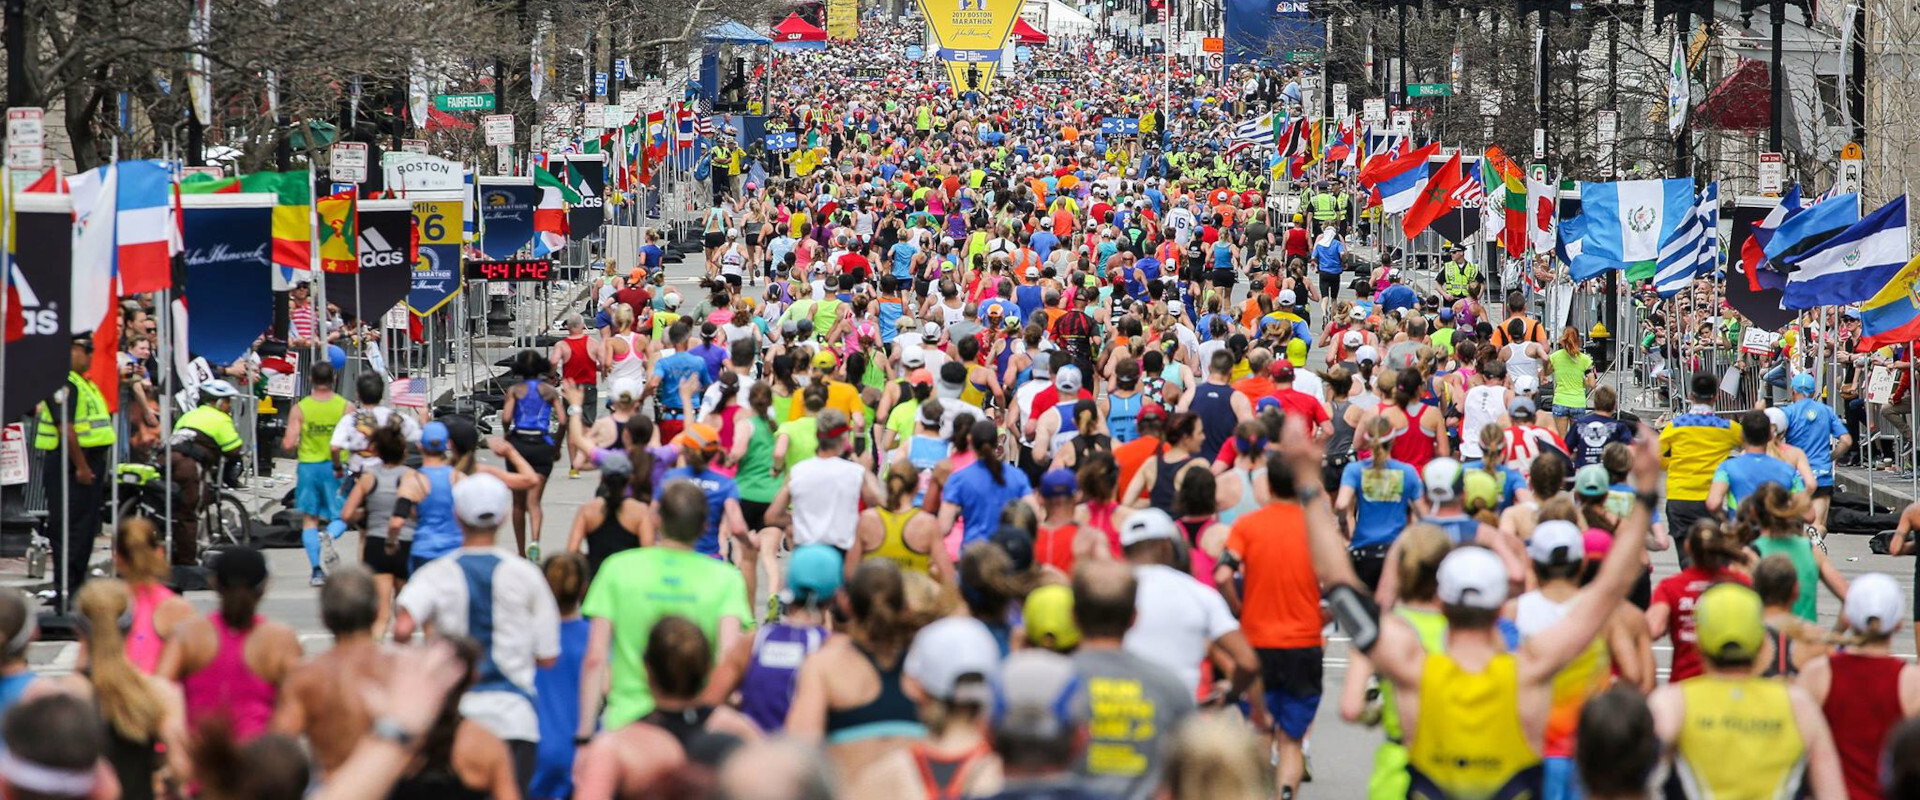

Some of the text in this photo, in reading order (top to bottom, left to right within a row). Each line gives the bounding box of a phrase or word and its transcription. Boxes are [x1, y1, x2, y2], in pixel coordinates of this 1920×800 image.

[1420, 85, 1434, 95] RING
[447, 96, 484, 108] FAIRFIELD
[1116, 119, 1125, 132] 3
[776, 135, 784, 148] 3
[397, 162, 450, 175] BOSTON
[412, 203, 438, 213] Mile
[1174, 216, 1186, 229] 16
[417, 270, 452, 278] MARATHON
[480, 261, 550, 279] 4:41:42
